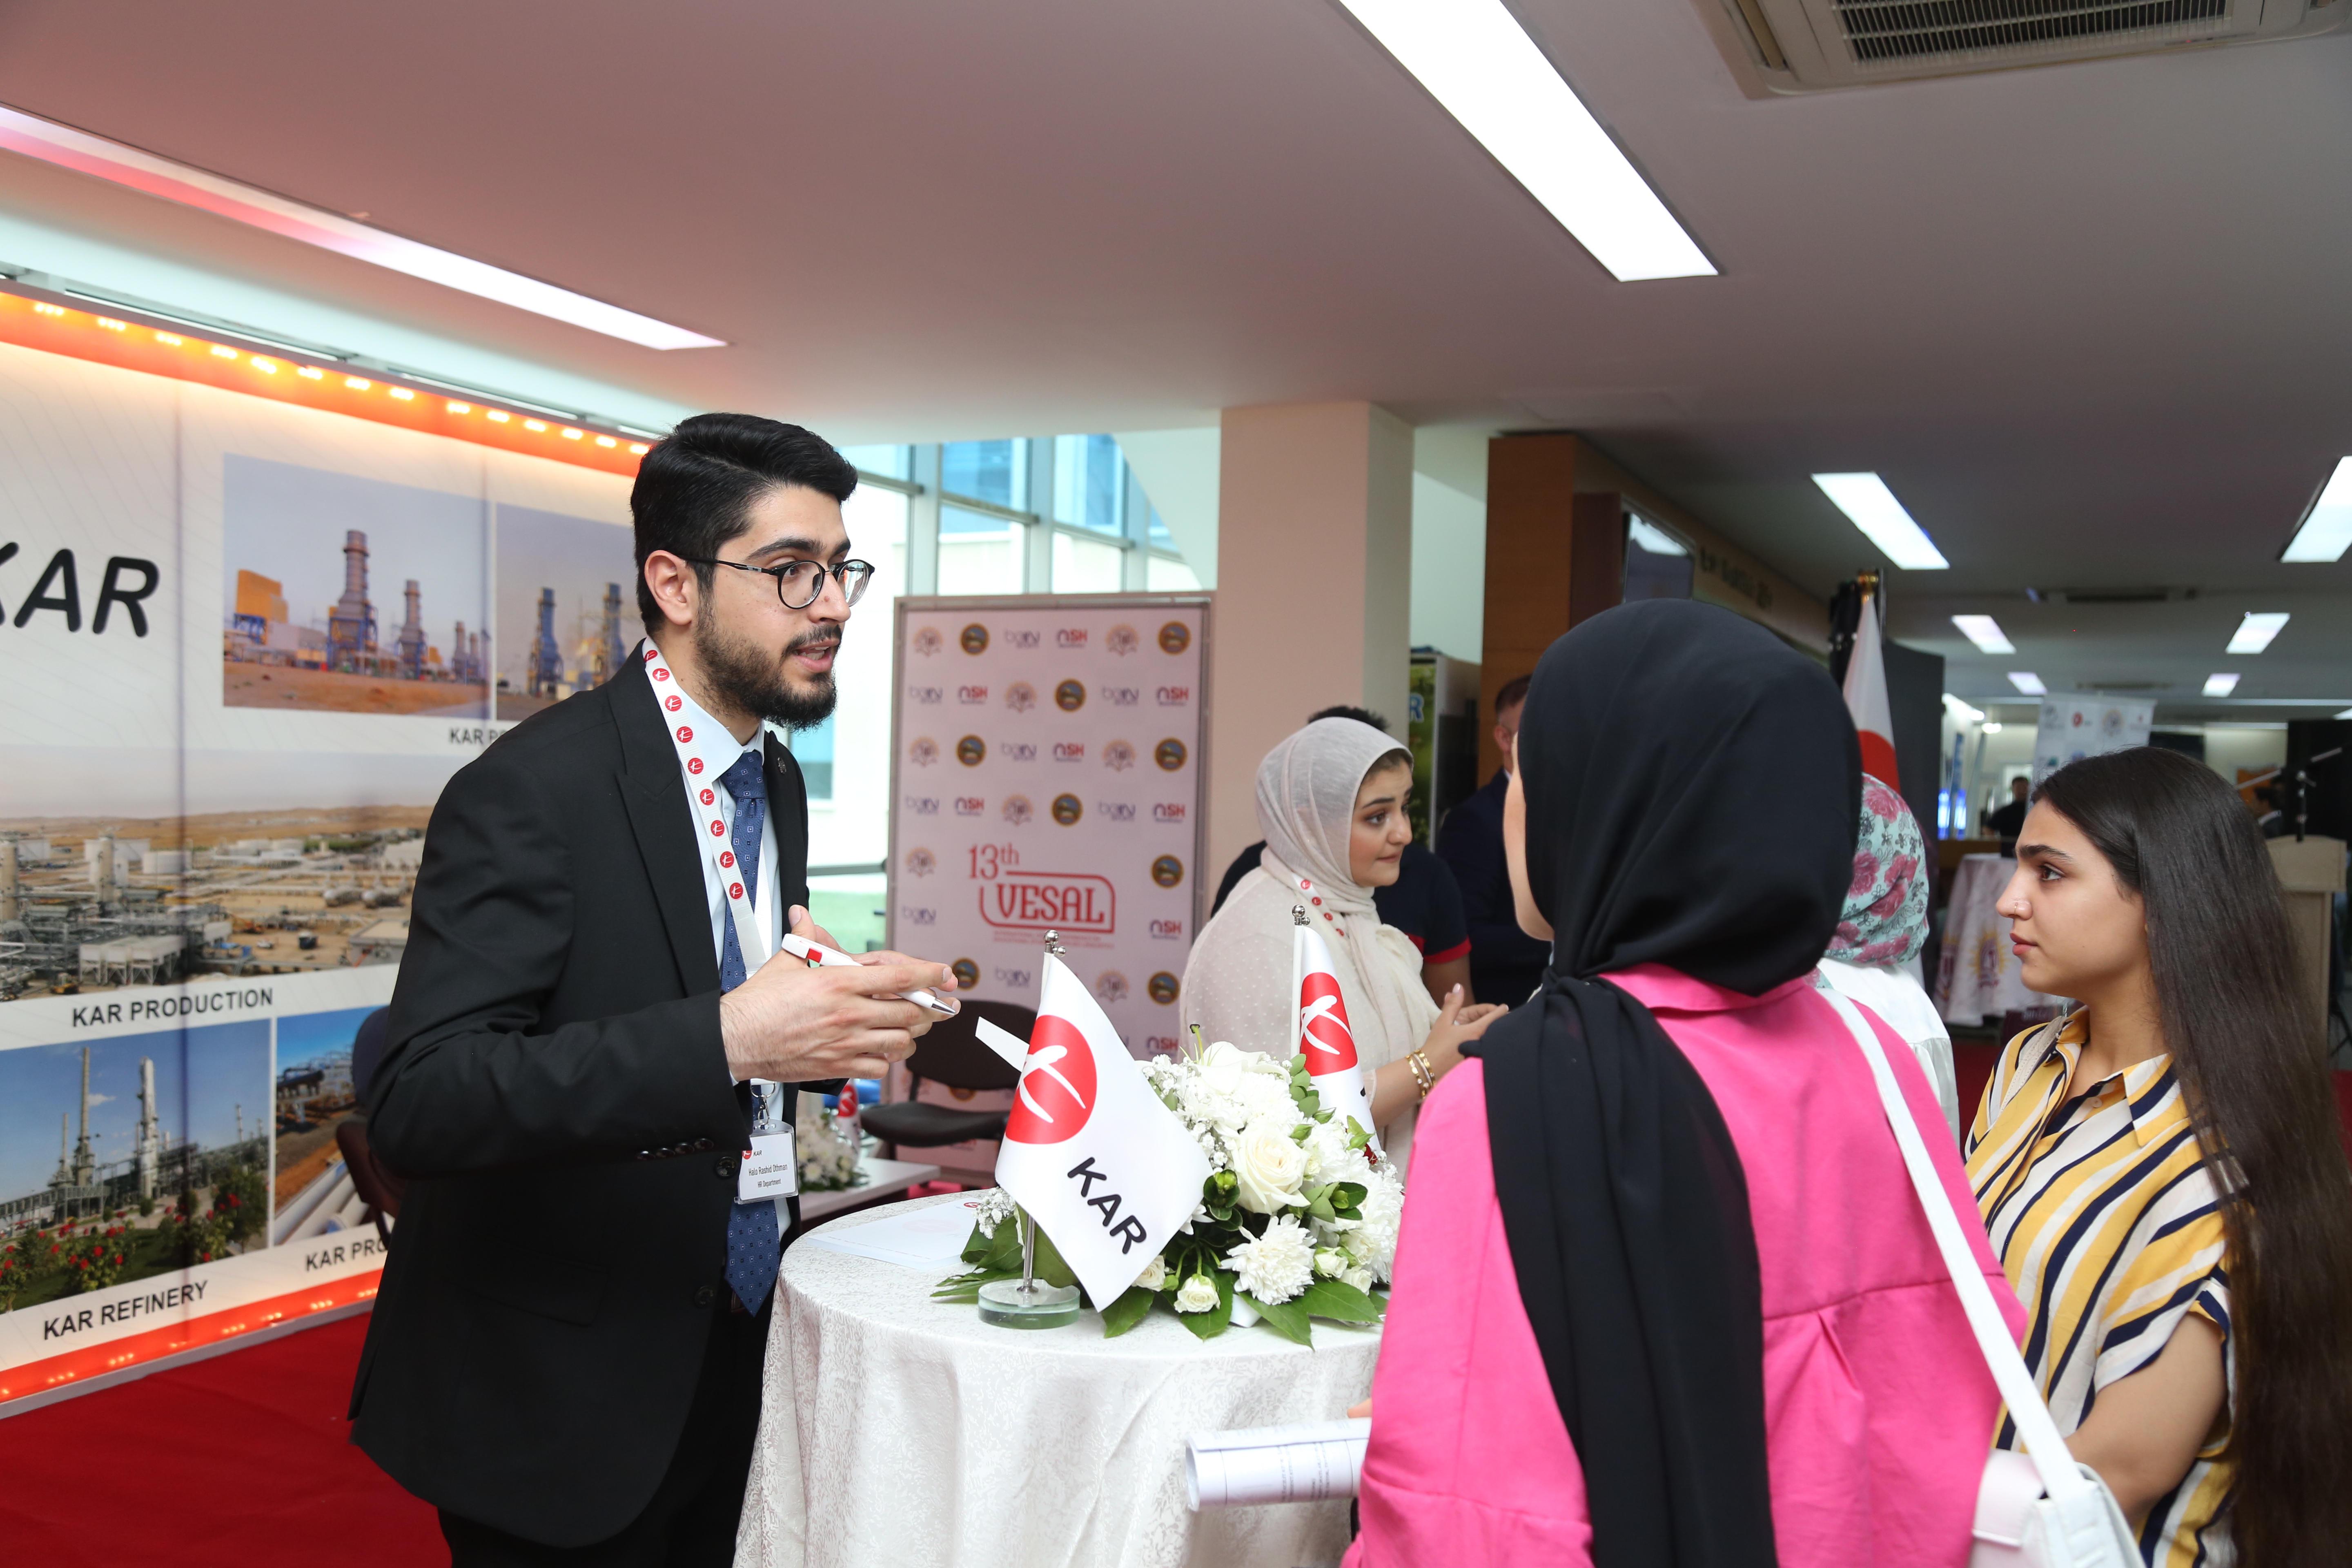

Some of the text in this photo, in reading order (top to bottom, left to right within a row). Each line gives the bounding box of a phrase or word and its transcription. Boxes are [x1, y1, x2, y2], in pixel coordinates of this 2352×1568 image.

[0, 541, 160, 638] AR
[451, 727, 484, 745] KAR
[968, 841, 1020, 880] 13th
[996, 882, 1105, 924] VESAL
[72, 987, 274, 1027] KAR PRODUCTION
[759, 1165, 772, 1175] Rashid
[773, 1164, 787, 1172] Othman
[763, 1179, 781, 1187] Department
[1067, 1157, 1147, 1254] KAR
[306, 1246, 345, 1272] KAR
[43, 1281, 207, 1341] KAR REFINERY
